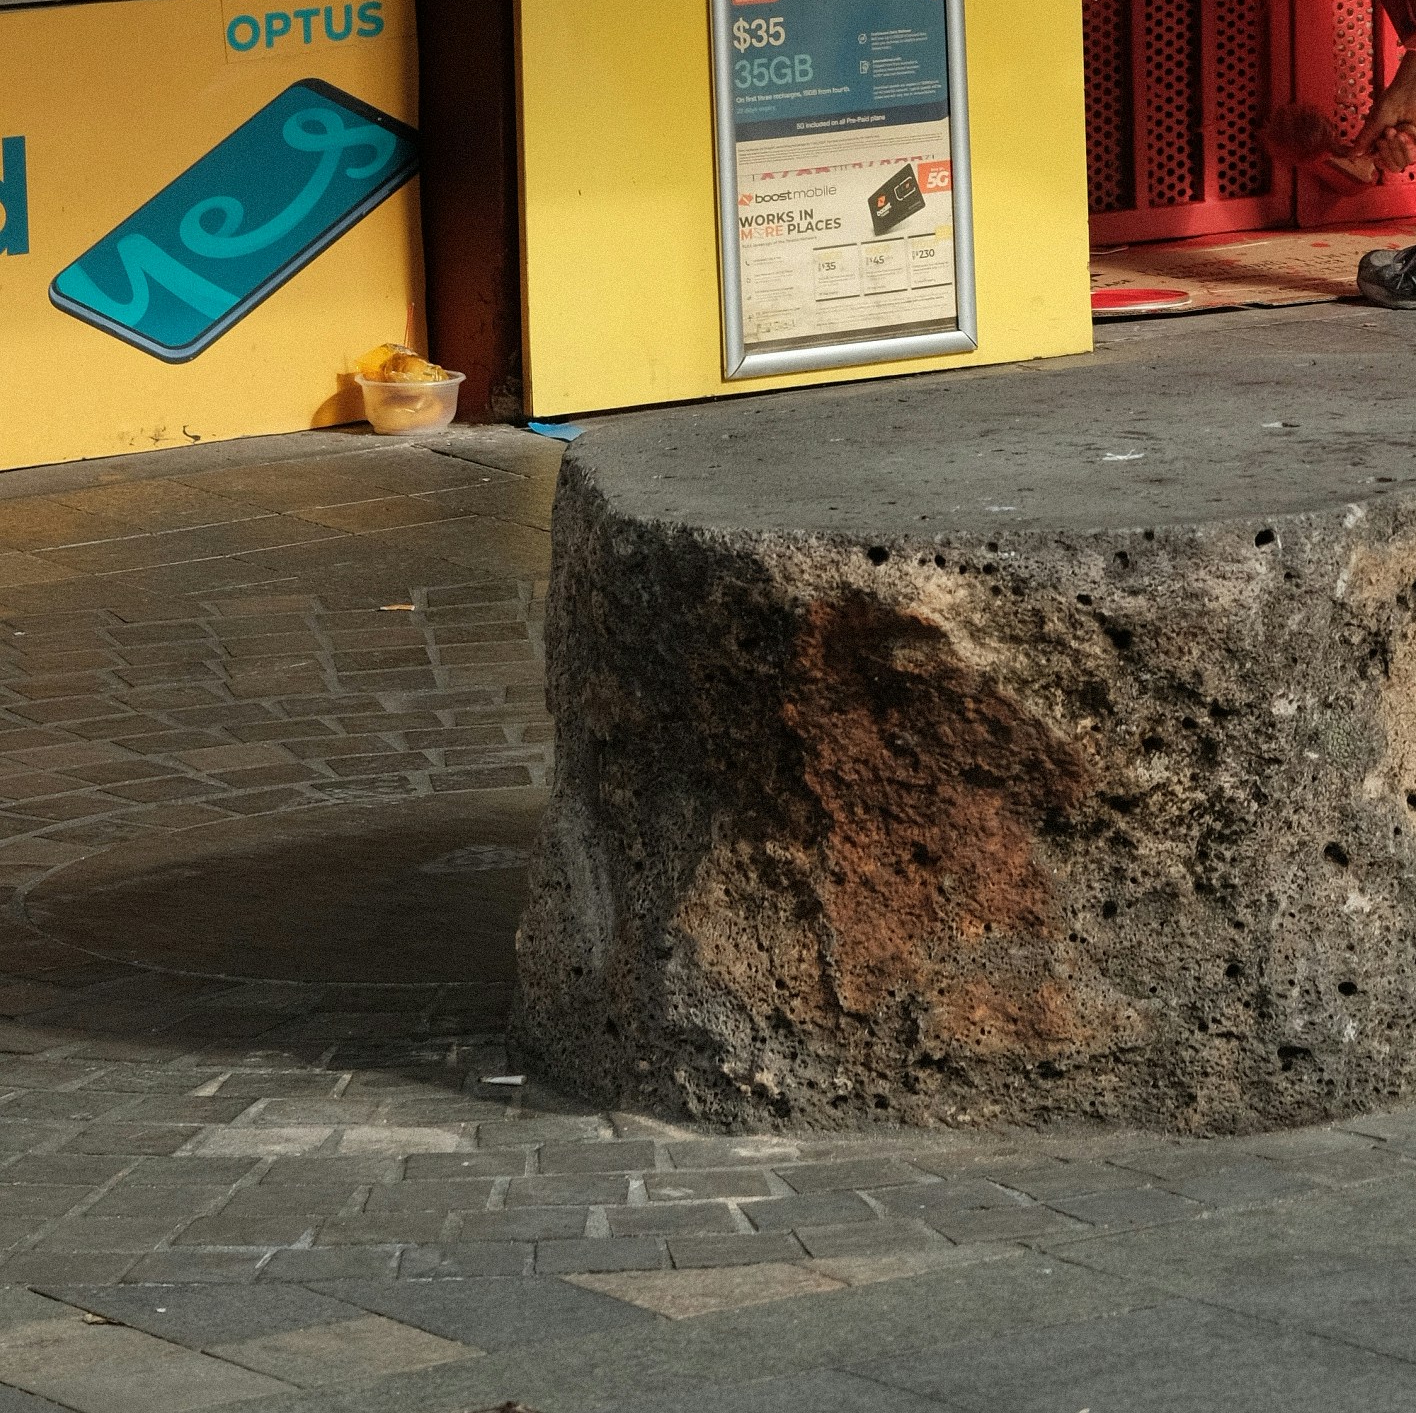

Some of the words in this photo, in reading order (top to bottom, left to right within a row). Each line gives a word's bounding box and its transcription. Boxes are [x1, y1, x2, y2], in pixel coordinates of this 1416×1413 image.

[226, 0, 385, 53] OPTUS
[732, 16, 787, 54] $35
[733, 53, 815, 89] 35GB
[926, 170, 950, 189] 5G
[739, 211, 795, 229] WORKS
[799, 208, 814, 221] IN
[740, 224, 785, 241] MRE
[786, 217, 842, 236] PLACES
